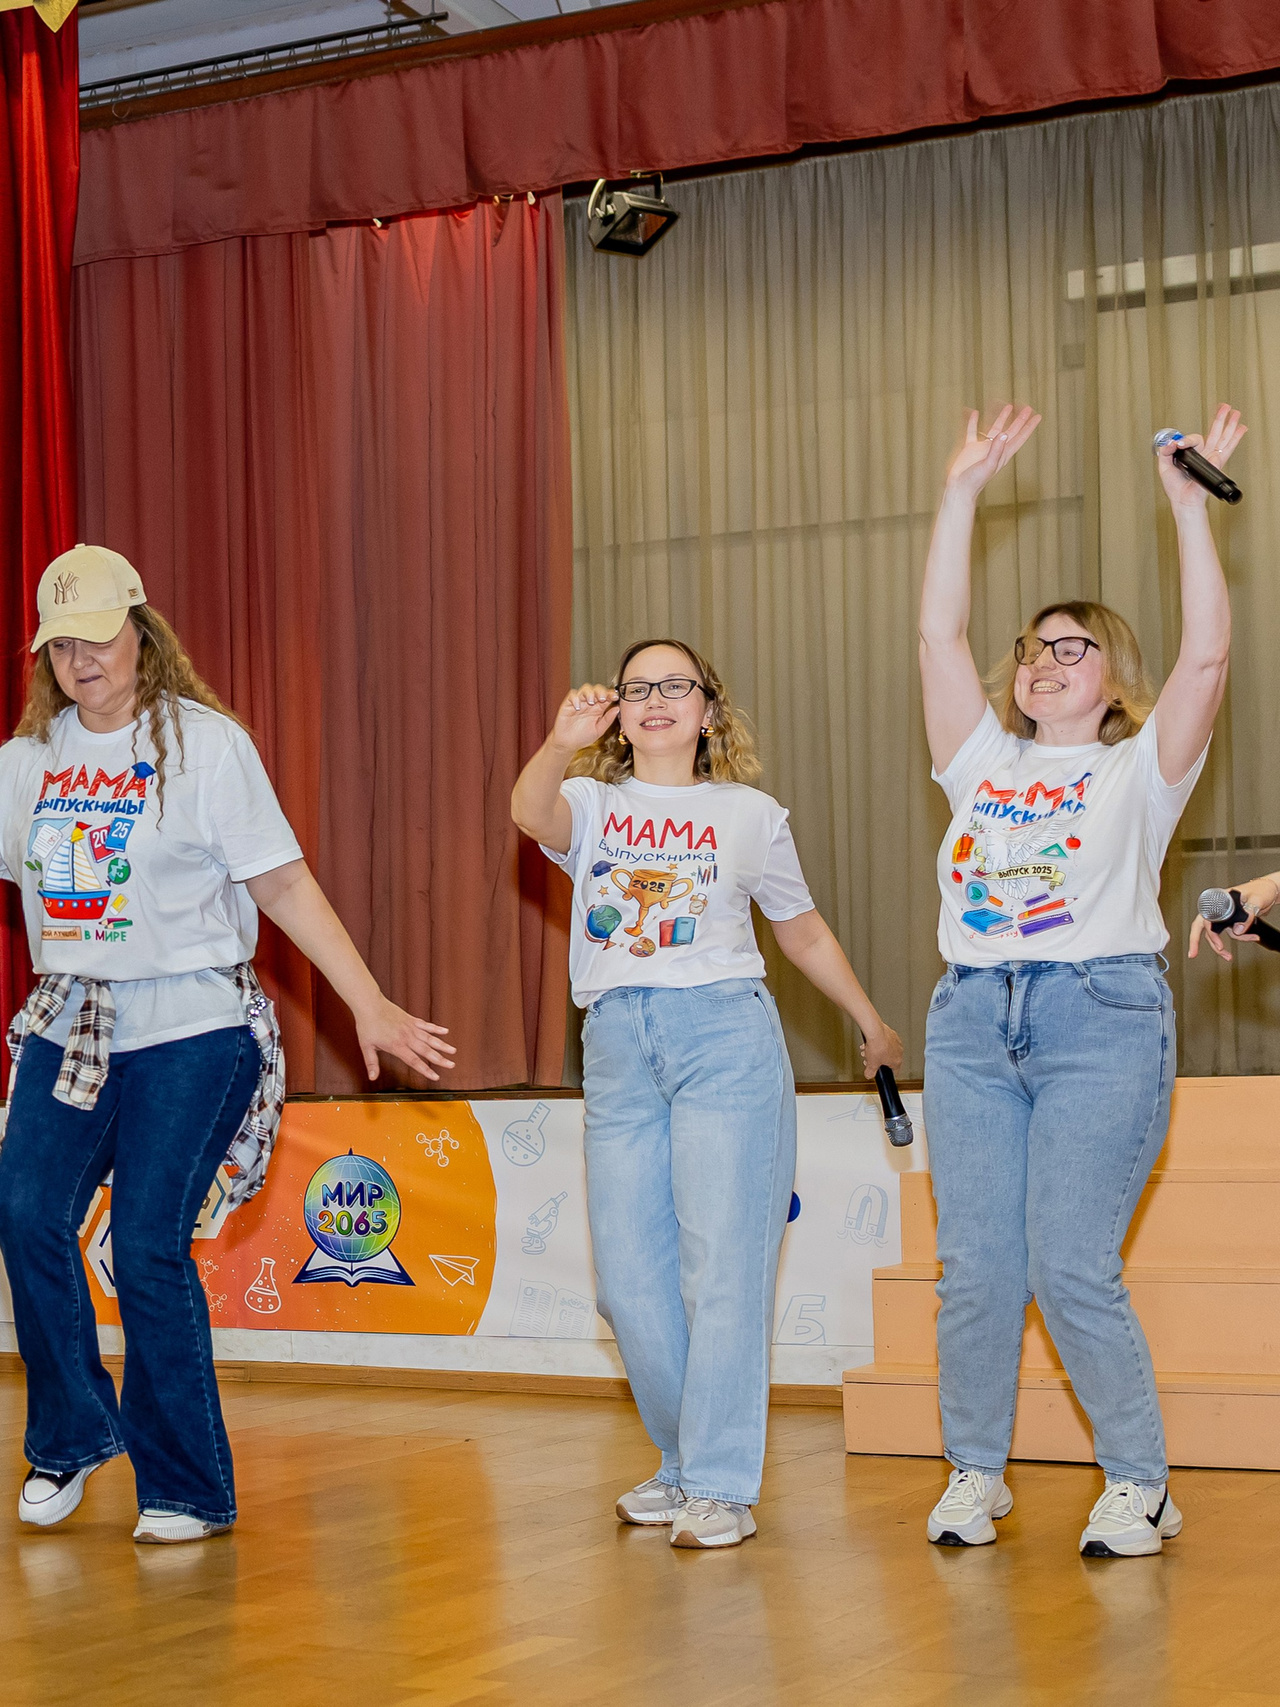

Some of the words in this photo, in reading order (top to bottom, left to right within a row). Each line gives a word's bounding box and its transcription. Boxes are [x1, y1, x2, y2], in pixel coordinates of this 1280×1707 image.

[39, 763, 147, 800] МАМА
[33, 798, 145, 815] ВЫПУСКНИЦЫ
[111, 821, 130, 839] 25
[603, 812, 718, 850] МАМА
[998, 868, 1030, 879] ВЫПУСК
[1032, 866, 1052, 875] 2025
[632, 880, 666, 893] 2025
[96, 930, 127, 941] МИРЕ
[322, 1181, 385, 1208] МИР
[318, 1210, 388, 1236] 2065
